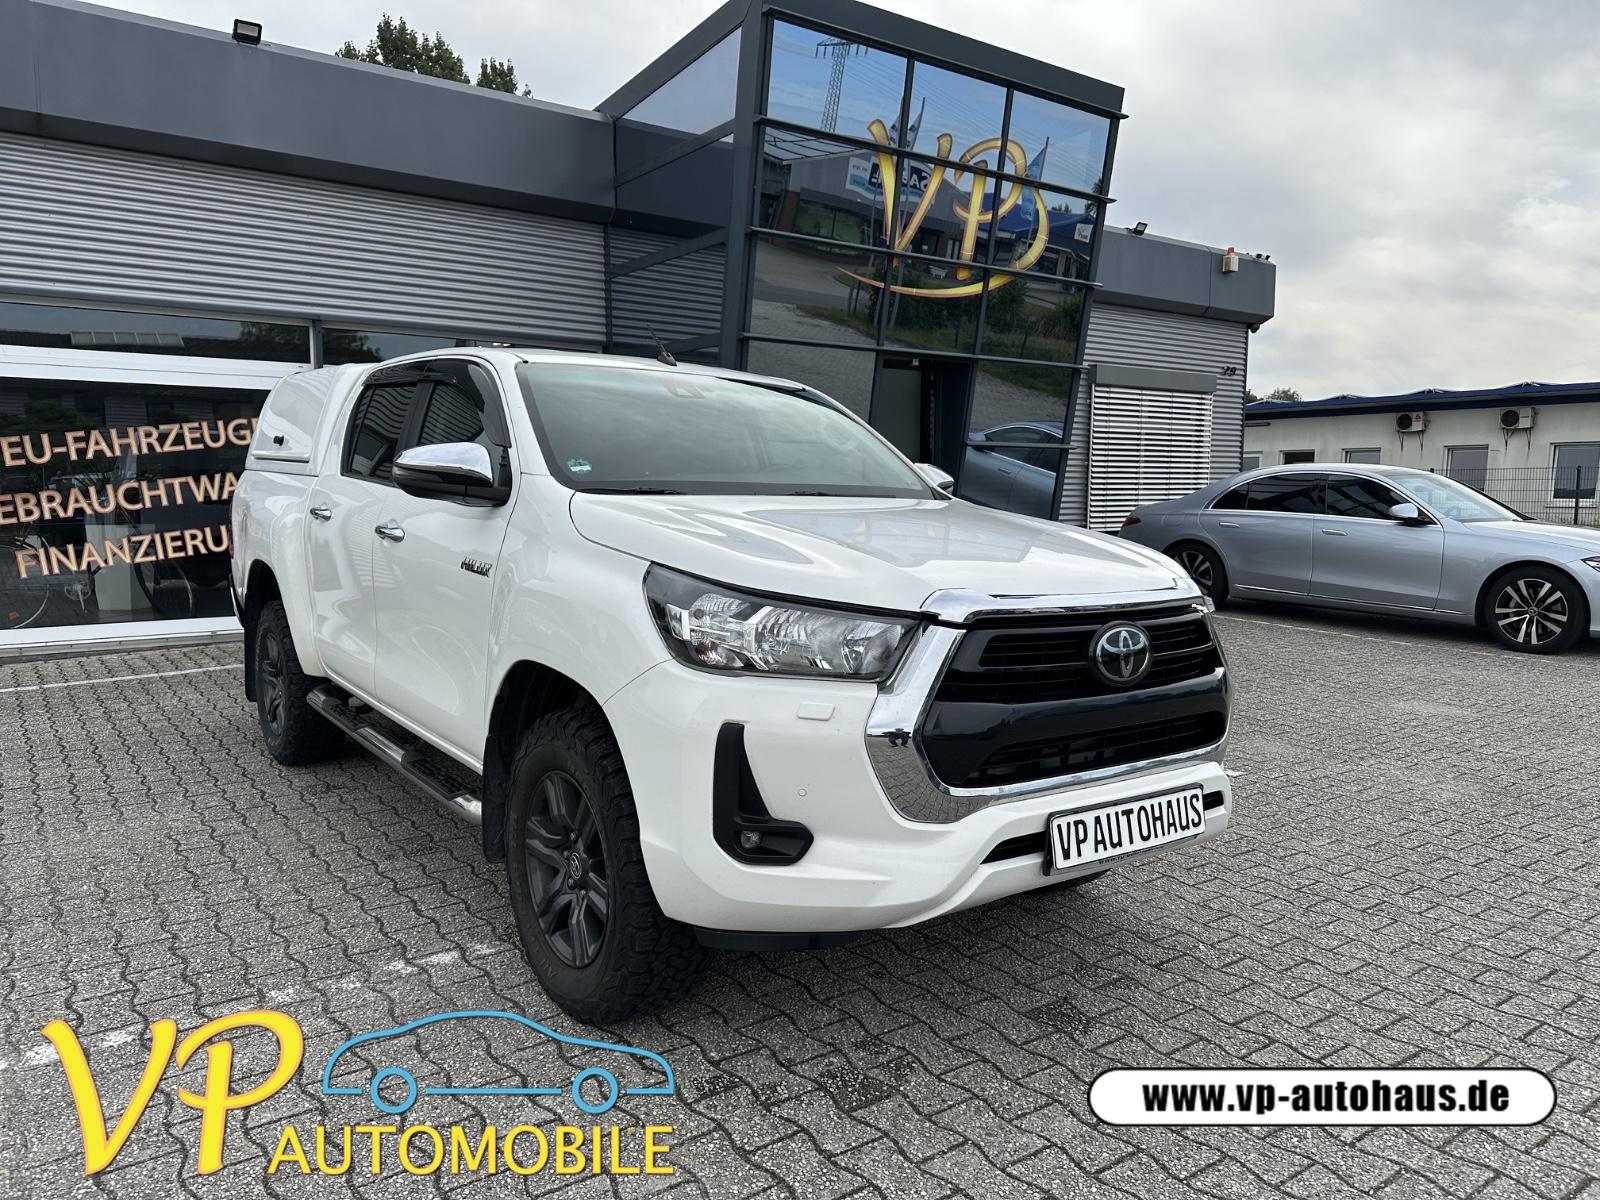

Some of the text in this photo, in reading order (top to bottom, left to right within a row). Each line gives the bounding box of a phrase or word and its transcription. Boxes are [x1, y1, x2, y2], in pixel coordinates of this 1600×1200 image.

[866, 117, 1049, 290] VP
[1056, 793, 1203, 861] VP AUTOHAUS
